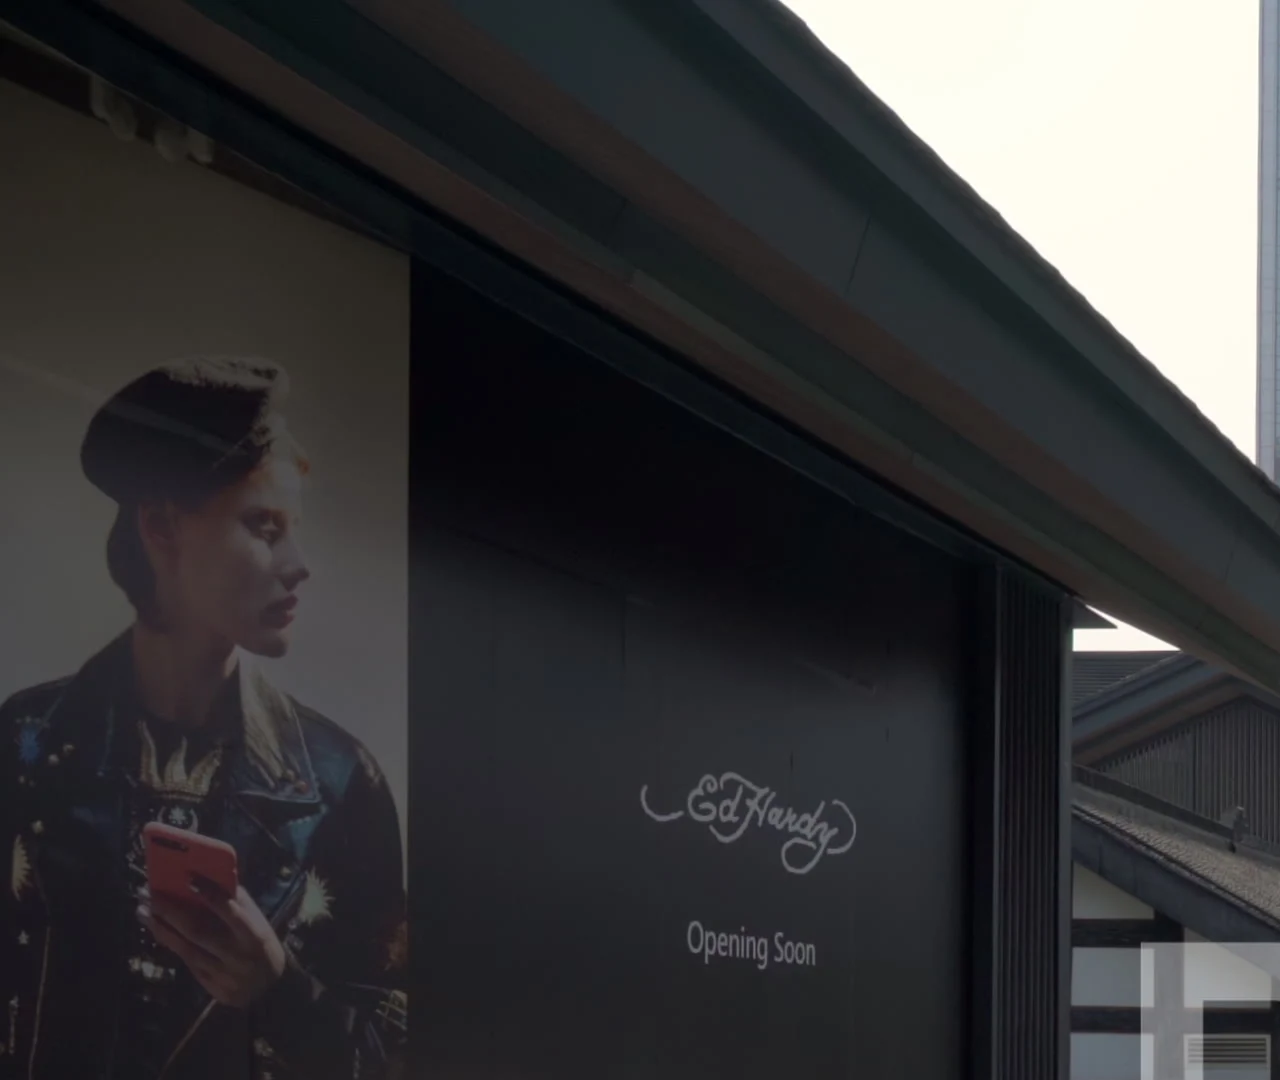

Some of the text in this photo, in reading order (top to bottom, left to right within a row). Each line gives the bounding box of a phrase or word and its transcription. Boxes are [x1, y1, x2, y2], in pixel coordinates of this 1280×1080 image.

[709, 772, 857, 874] Hardy
[687, 920, 817, 970] Opening Soon
